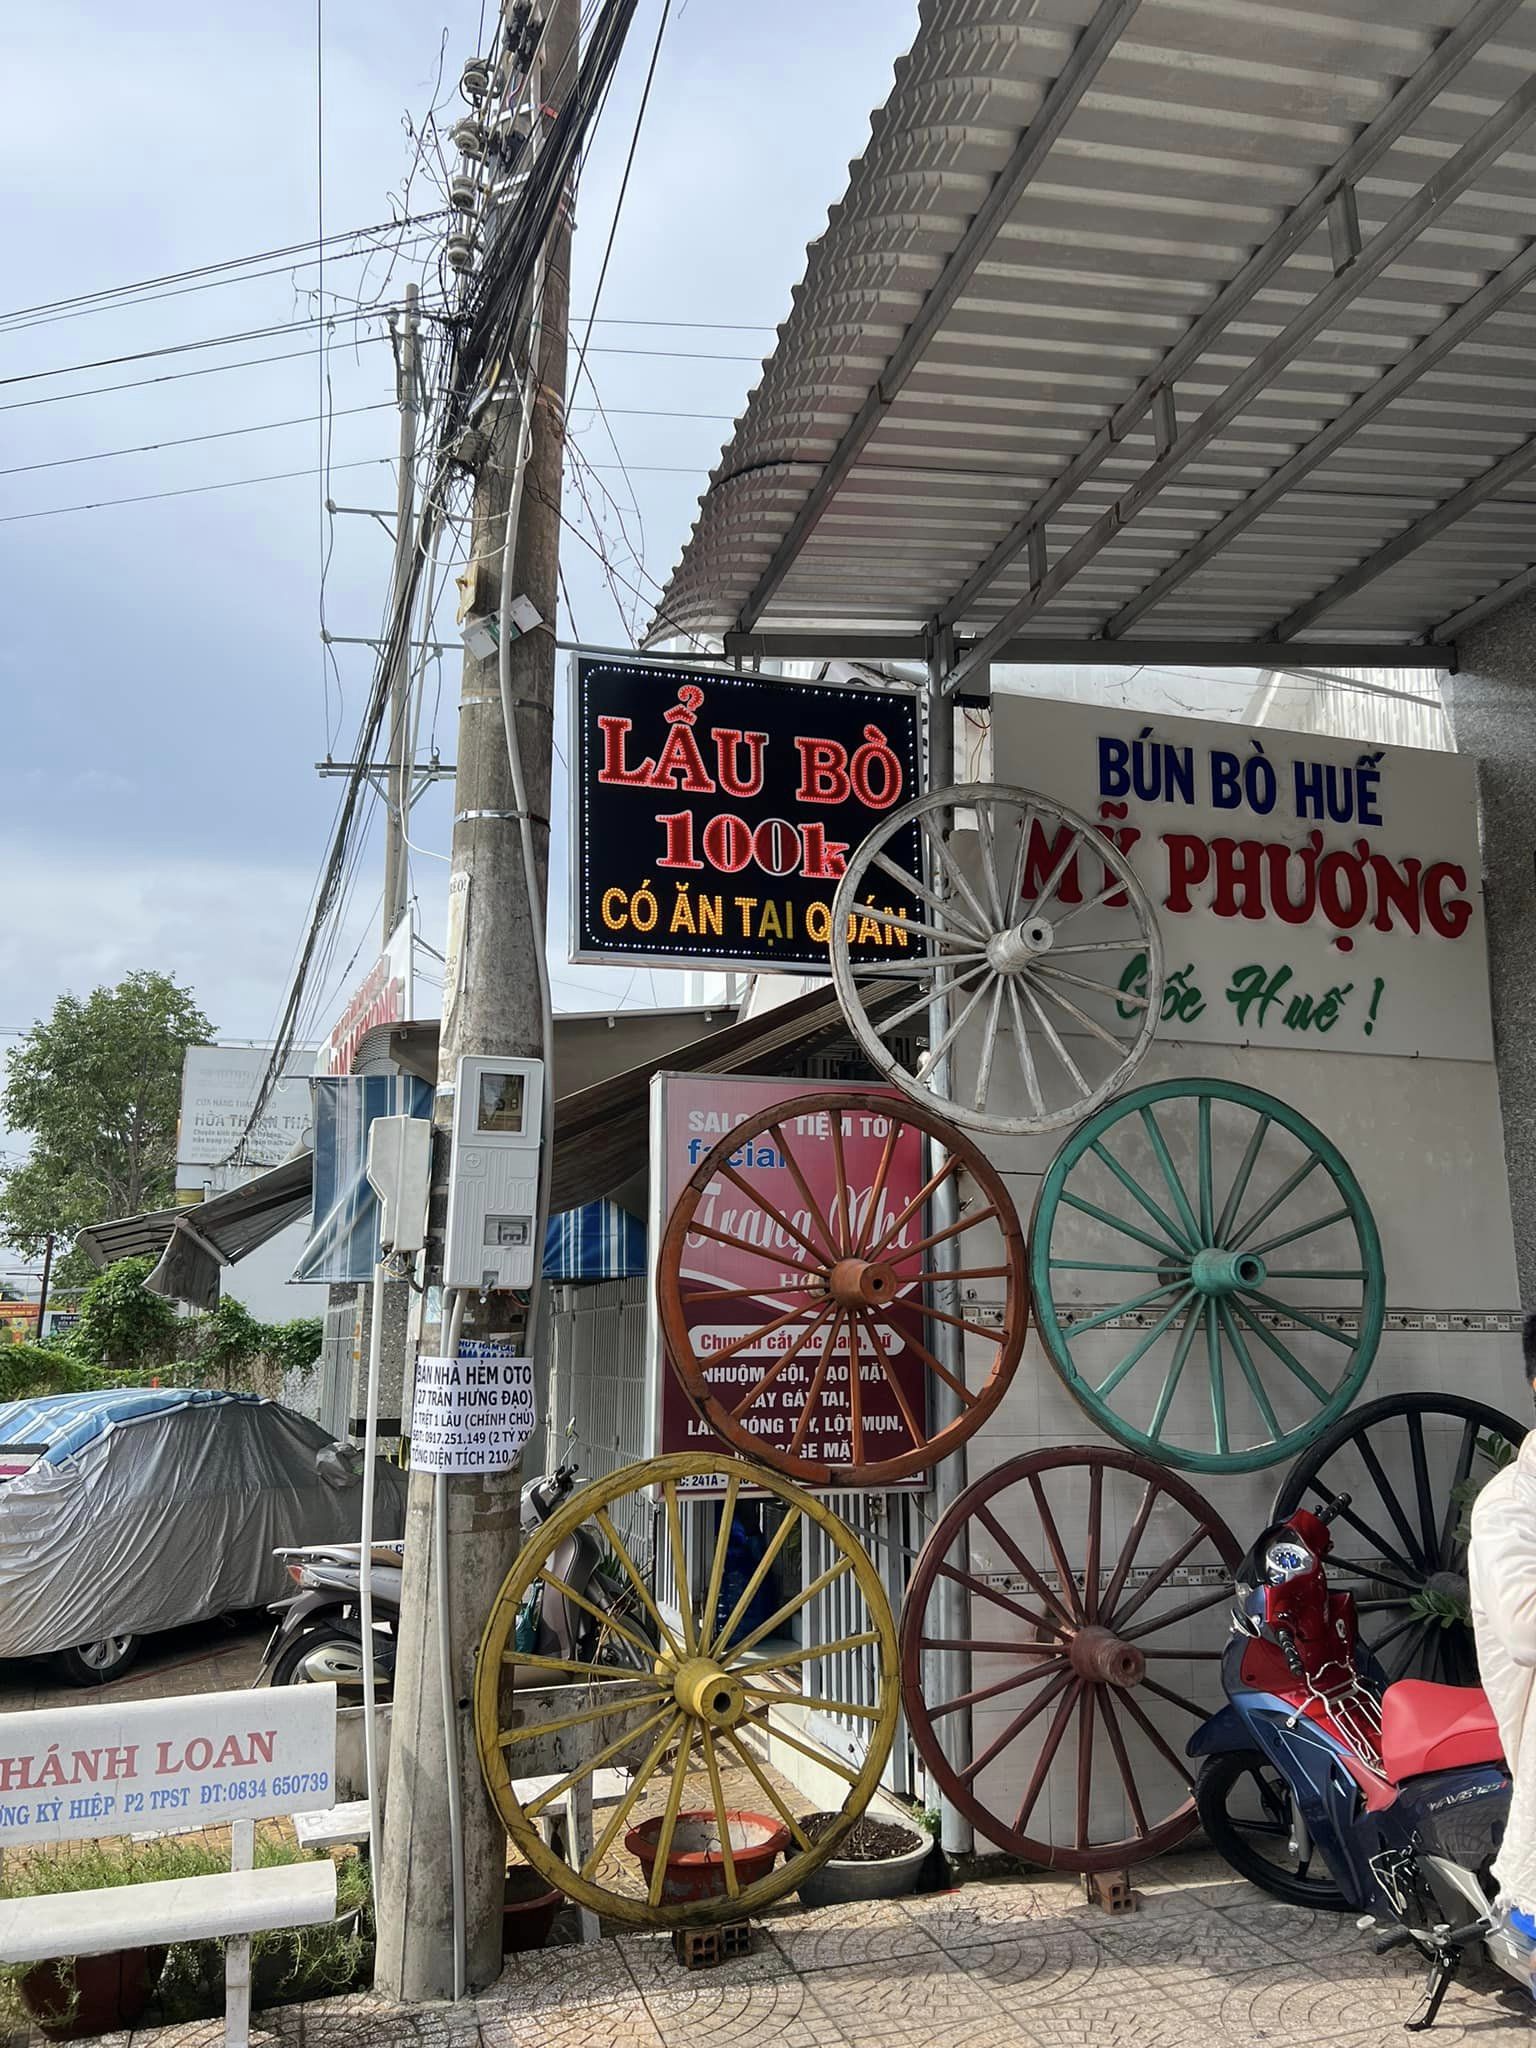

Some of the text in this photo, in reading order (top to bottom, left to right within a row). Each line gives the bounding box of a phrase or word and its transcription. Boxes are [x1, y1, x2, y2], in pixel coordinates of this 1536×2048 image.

[598, 685, 903, 809] LẨU BÒ
[1099, 727, 1386, 826] BÚN BÒ HUẾ
[655, 810, 850, 880] 100k
[1016, 801, 1473, 953] MỸ PHƯỢNG
[601, 880, 659, 932] CÓ
[670, 881, 724, 936] ĂN
[733, 896, 794, 946] TẠI
[1115, 953, 1385, 1036] Gốc Huế !
[416, 1360, 532, 1385] BÁN NHÀ HẺM OTO
[702, 1364, 766, 1386] NHUỘM
[815, 1364, 848, 1386] ẠO
[457, 1387, 498, 1408] HƯNG
[501, 1389, 533, 1409] ĐẠO)
[820, 1391, 850, 1408] TAI,
[465, 1410, 506, 1429] (CHÍNH
[509, 1408, 535, 1427] CHỦ)
[789, 1416, 820, 1434] TY,
[825, 1414, 854, 1435] LỘT
[861, 1415, 904, 1435] MỤN,
[425, 1430, 486, 1444] 0917.251.149
[488, 1431, 499, 1446] (2
[503, 1427, 515, 1443] TỶ
[429, 1447, 452, 1469] DIỆN
[456, 1447, 485, 1465] TÍCH
[823, 1439, 853, 1462] MẶ
[692, 1475, 718, 1487] 241A
[155, 1731, 278, 1775] LOAN
[36, 1796, 63, 1823] KỲ
[69, 1792, 115, 1824] HIỆP
[124, 1792, 144, 1814] P2
[150, 1787, 191, 1810] TPST
[200, 1778, 267, 1805] ĐT:0834
[272, 1771, 329, 1798] 650739
